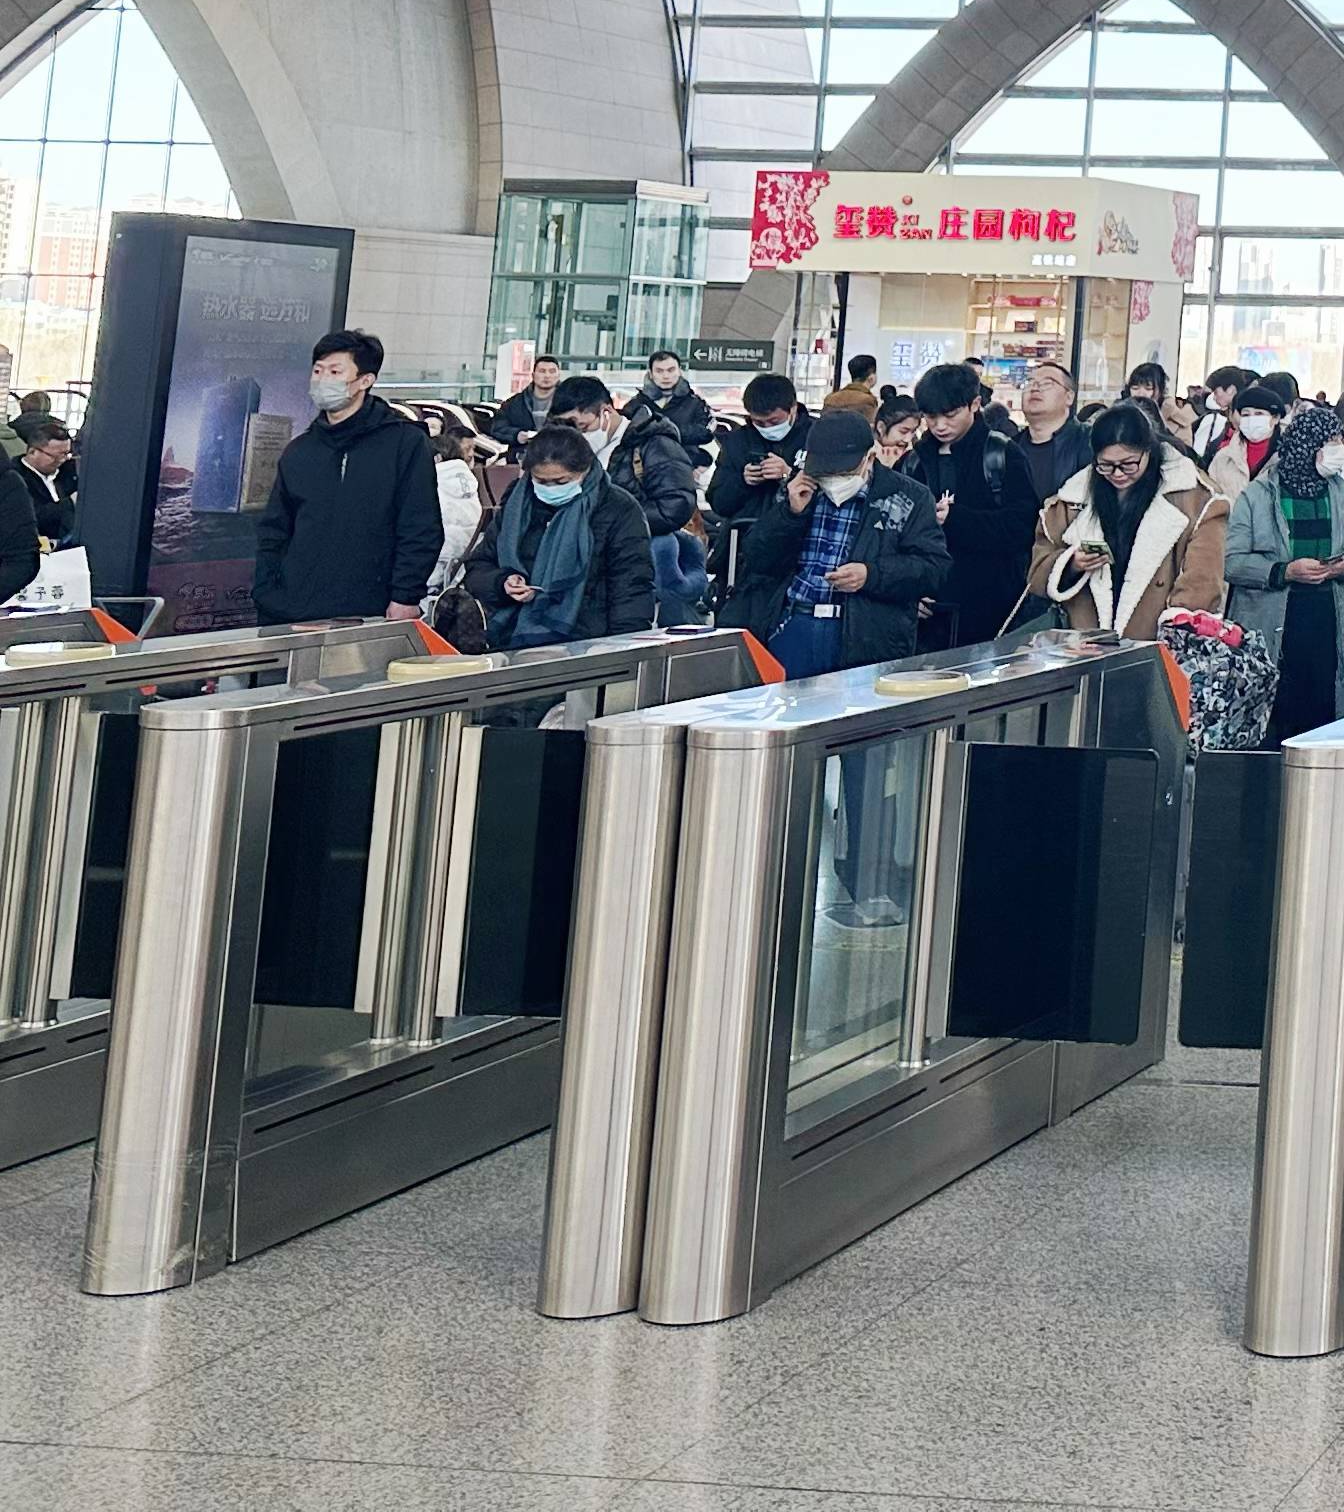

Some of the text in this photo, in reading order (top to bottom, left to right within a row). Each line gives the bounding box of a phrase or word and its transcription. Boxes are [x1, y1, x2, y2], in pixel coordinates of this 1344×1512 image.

[834, 205, 897, 239] 玺赞
[937, 206, 1077, 242] 庄园枸杞
